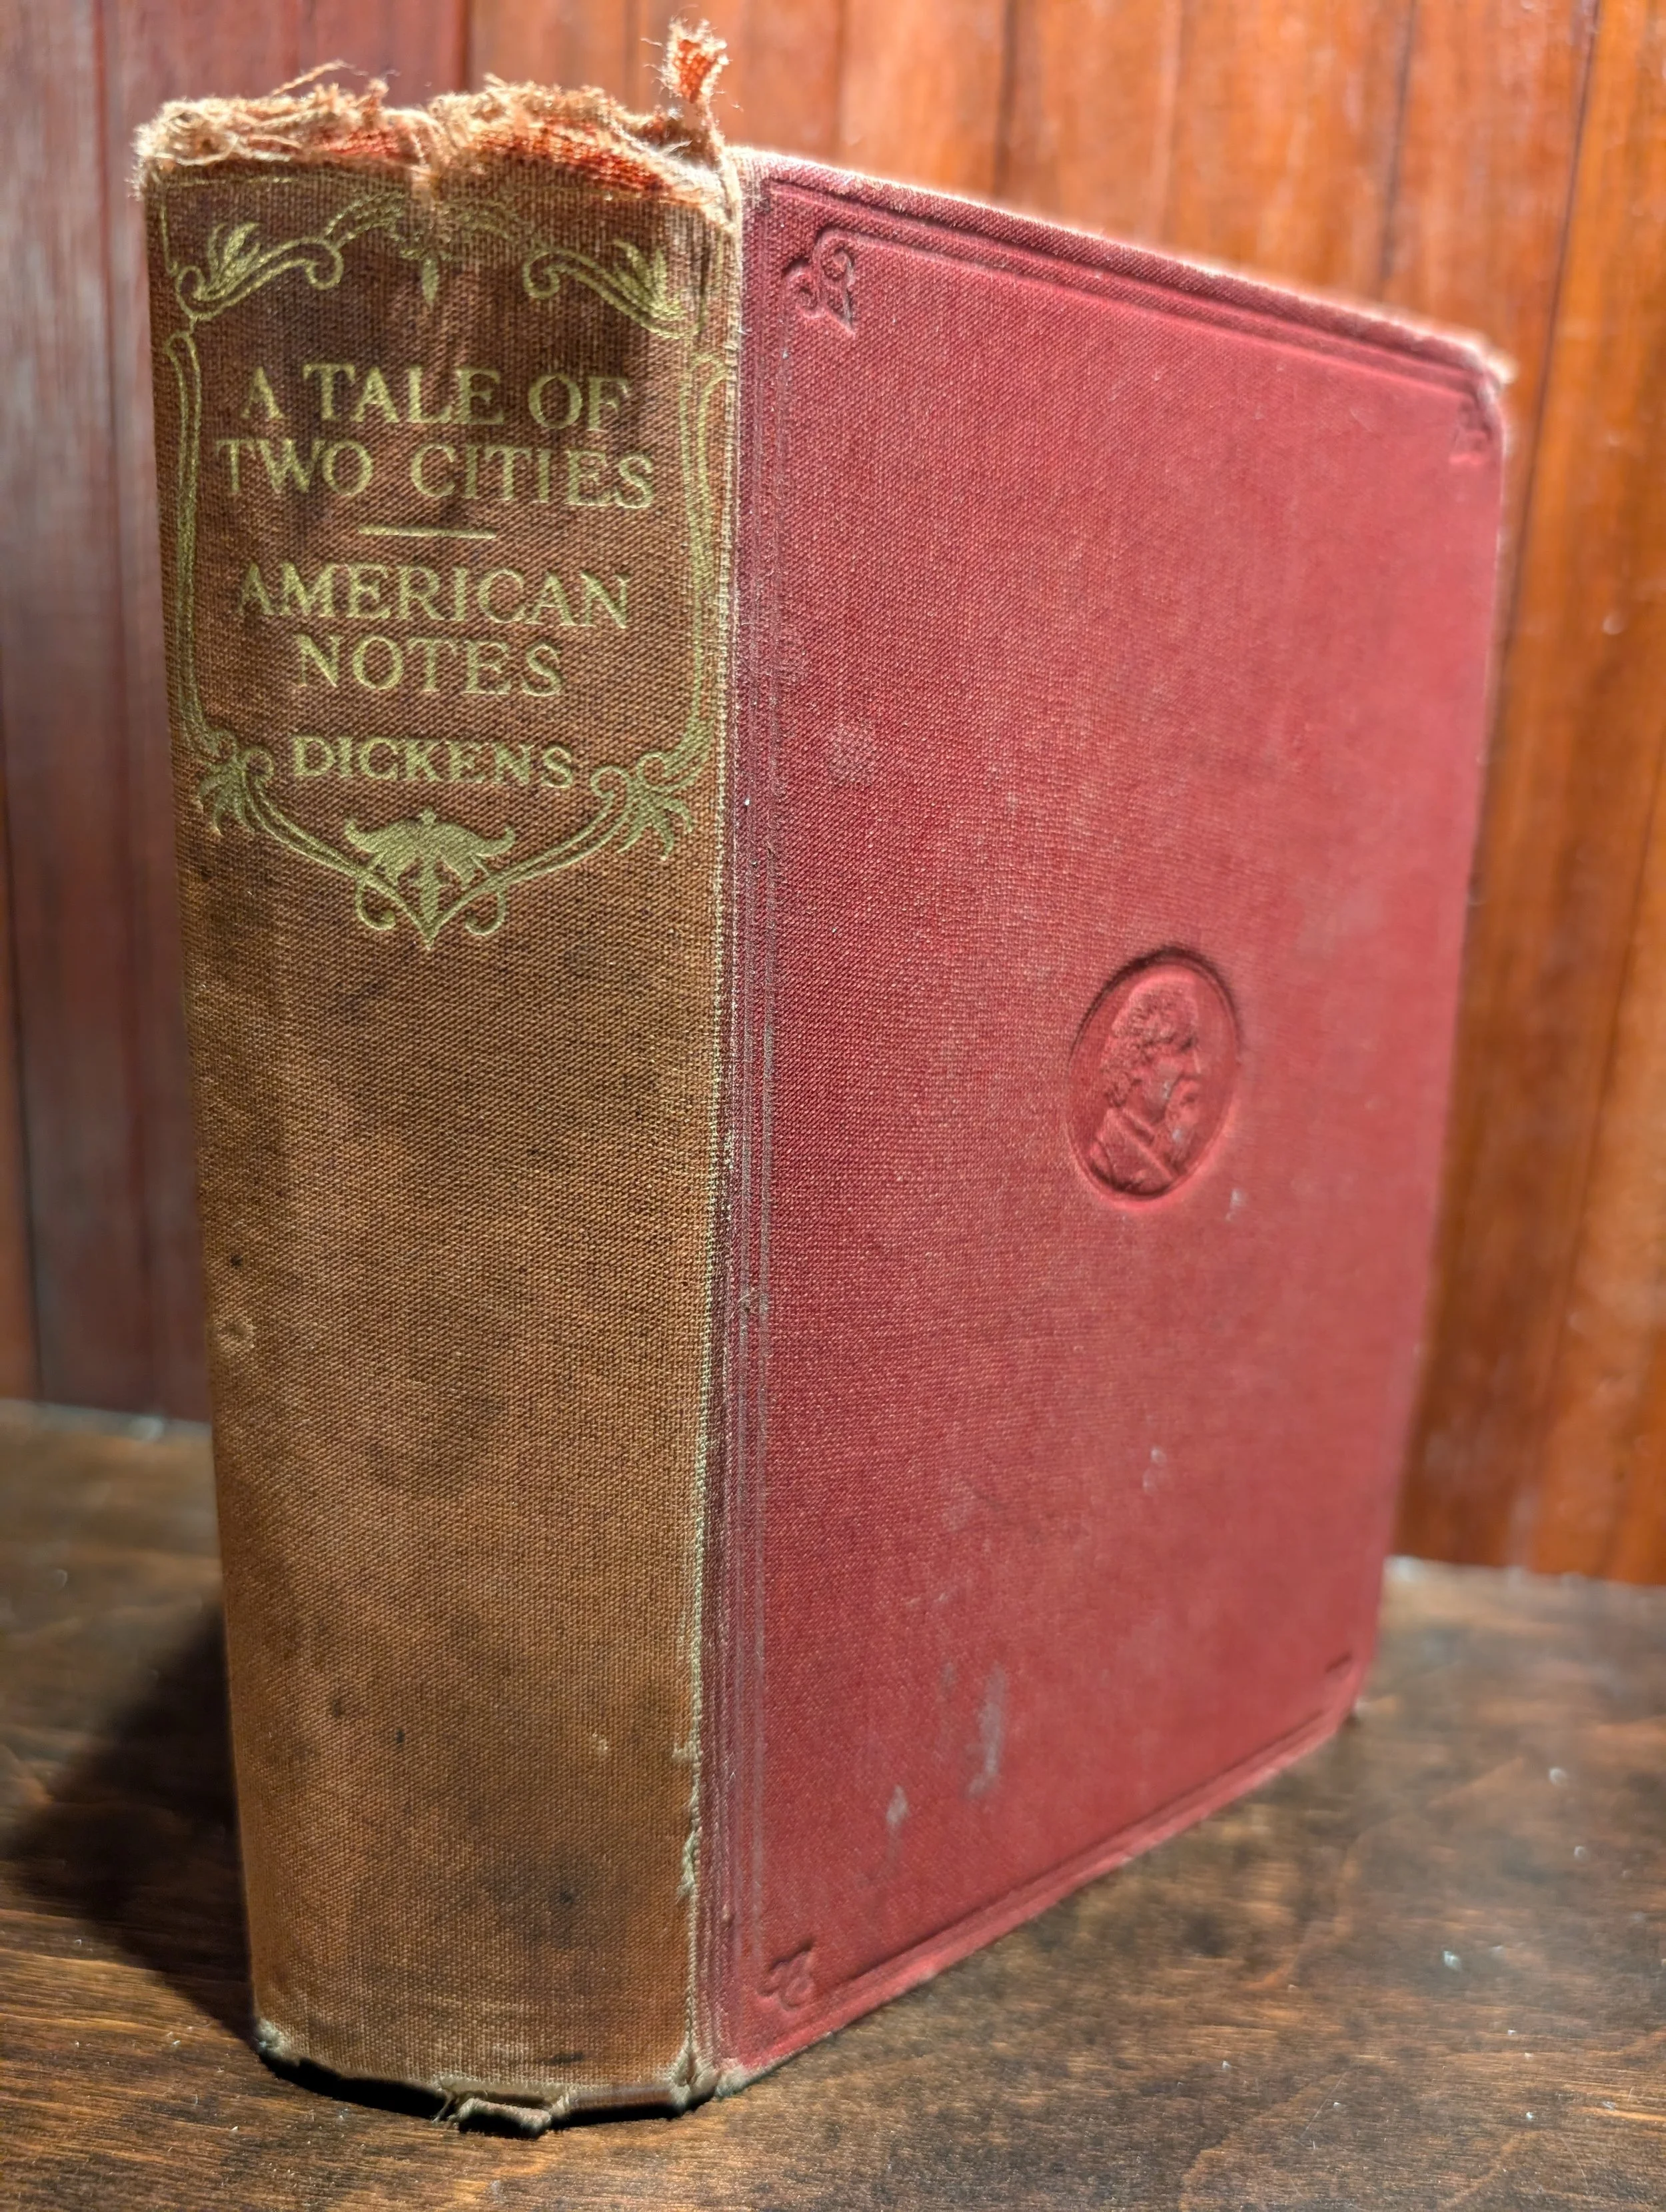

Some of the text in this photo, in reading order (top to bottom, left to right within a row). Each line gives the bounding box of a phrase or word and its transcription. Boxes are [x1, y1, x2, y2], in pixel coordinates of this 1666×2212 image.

[242, 363, 630, 434] A TALE OF
[217, 437, 656, 509] TWO CITIES
[239, 562, 630, 630] AMERICAN
[295, 634, 564, 698] NOTES
[293, 736, 574, 790] DICKENS
